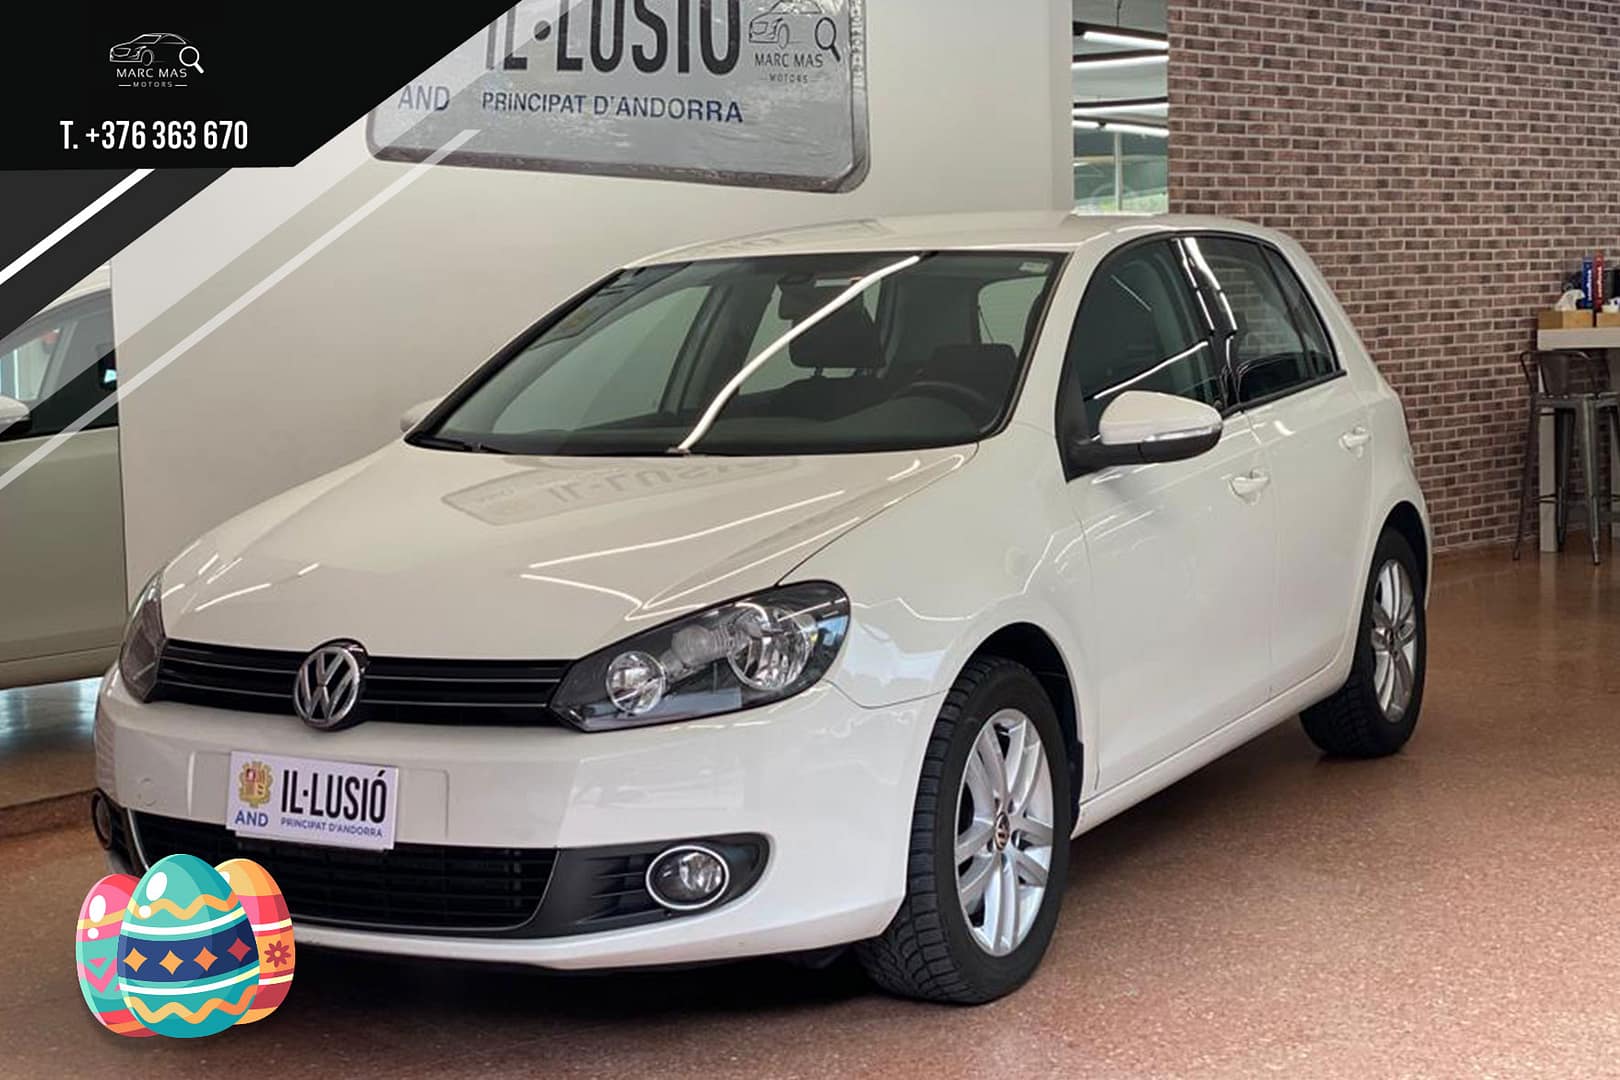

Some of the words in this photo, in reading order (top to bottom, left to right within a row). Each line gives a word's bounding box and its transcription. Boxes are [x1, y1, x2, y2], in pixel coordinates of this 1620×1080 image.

[755, 53, 789, 68] MARC
[793, 53, 824, 69] MAS
[398, 86, 450, 111] AND
[482, 92, 587, 114] PRINCIPAT
[593, 95, 744, 123] D'ANDORRA
[235, 811, 269, 827] AND
[281, 817, 326, 832] PRINCIPAT
[329, 823, 383, 838] D'ANDORRA
